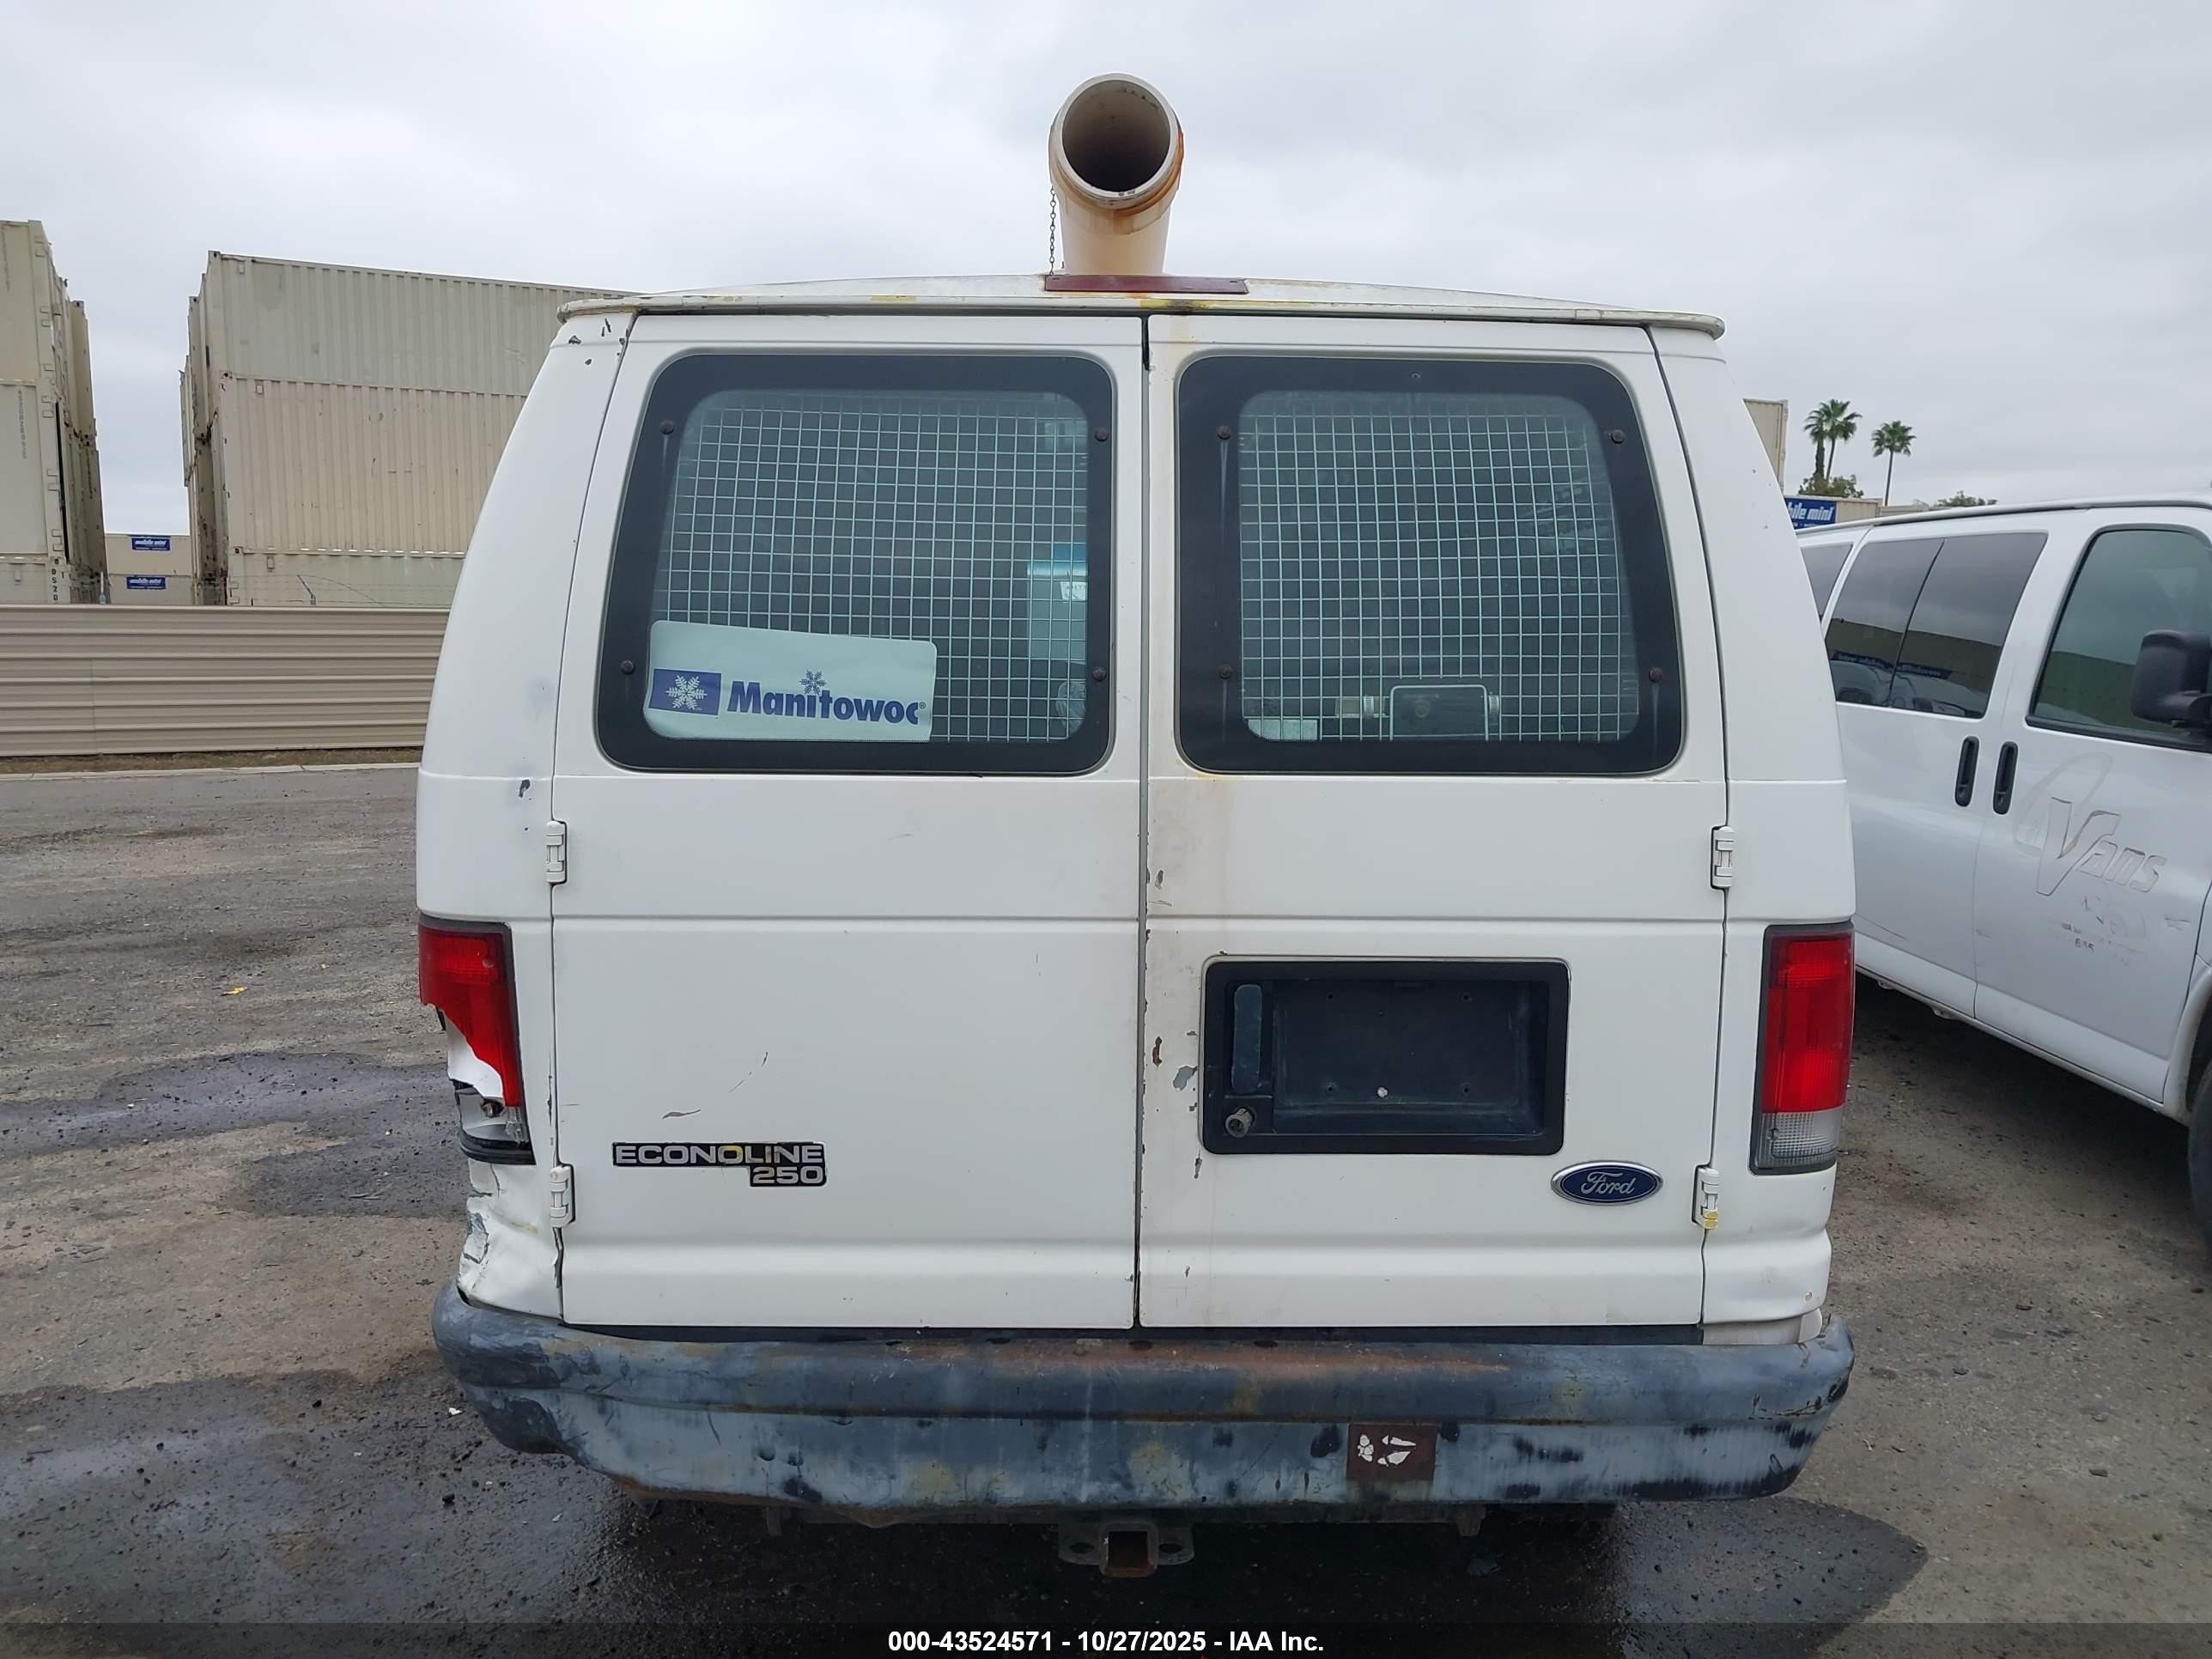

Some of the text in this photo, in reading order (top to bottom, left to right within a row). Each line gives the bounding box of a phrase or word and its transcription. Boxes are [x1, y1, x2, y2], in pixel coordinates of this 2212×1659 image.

[1807, 506, 1834, 521] mini
[615, 1145, 823, 1164] ECONOLINE
[752, 1165, 824, 1185] 250
[1580, 1171, 1637, 1194] Ford
